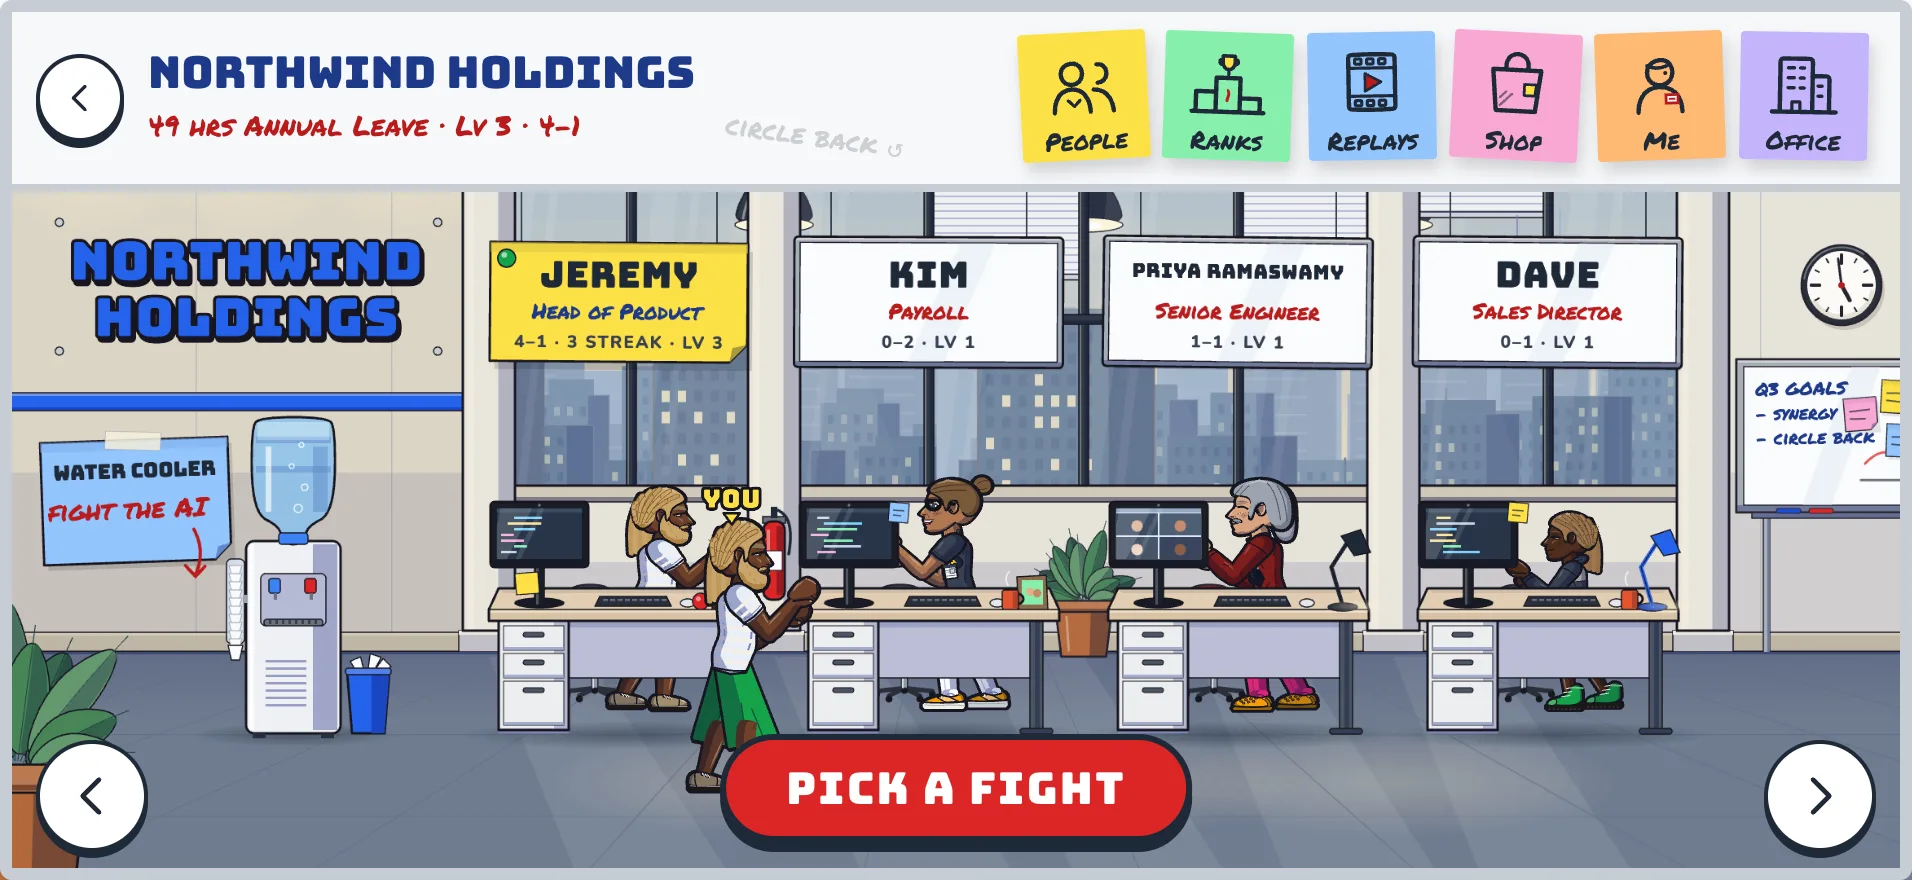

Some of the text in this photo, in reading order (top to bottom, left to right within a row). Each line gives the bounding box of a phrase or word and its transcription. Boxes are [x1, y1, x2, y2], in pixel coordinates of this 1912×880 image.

[151, 56, 693, 89] NORTHWIND HOLDINGS
[149, 115, 179, 137] 49
[495, 116, 511, 136] 3
[725, 119, 877, 153] CIRCLE BACK
[70, 238, 425, 287] NORTHWIND
[1133, 263, 1343, 280] PRIYA RAMASWAMY
[541, 261, 697, 288] JEREMY
[890, 261, 967, 288] KIM
[1497, 261, 1599, 288] DAVE
[95, 294, 402, 343] HOLDINGS
[568, 335, 577, 348] 3
[586, 335, 661, 348] STREAK
[683, 336, 704, 349] LV
[713, 336, 722, 349] 3
[935, 336, 956, 348] LV
[966, 336, 974, 348] 1
[1244, 336, 1265, 348] LV
[1275, 336, 1283, 349] 1
[1554, 336, 1575, 348] LV
[1585, 336, 1593, 348] 1
[1755, 381, 1849, 397] Q3 GOALS
[1773, 408, 1838, 421] SYNERGY
[1774, 433, 1827, 445] CIRCLE
[1832, 431, 1875, 444] BACK
[54, 460, 215, 481] WATER COOLER
[174, 497, 210, 518] AI
[701, 486, 762, 513] YOU
[789, 772, 1123, 804] PICK A FIGHT
